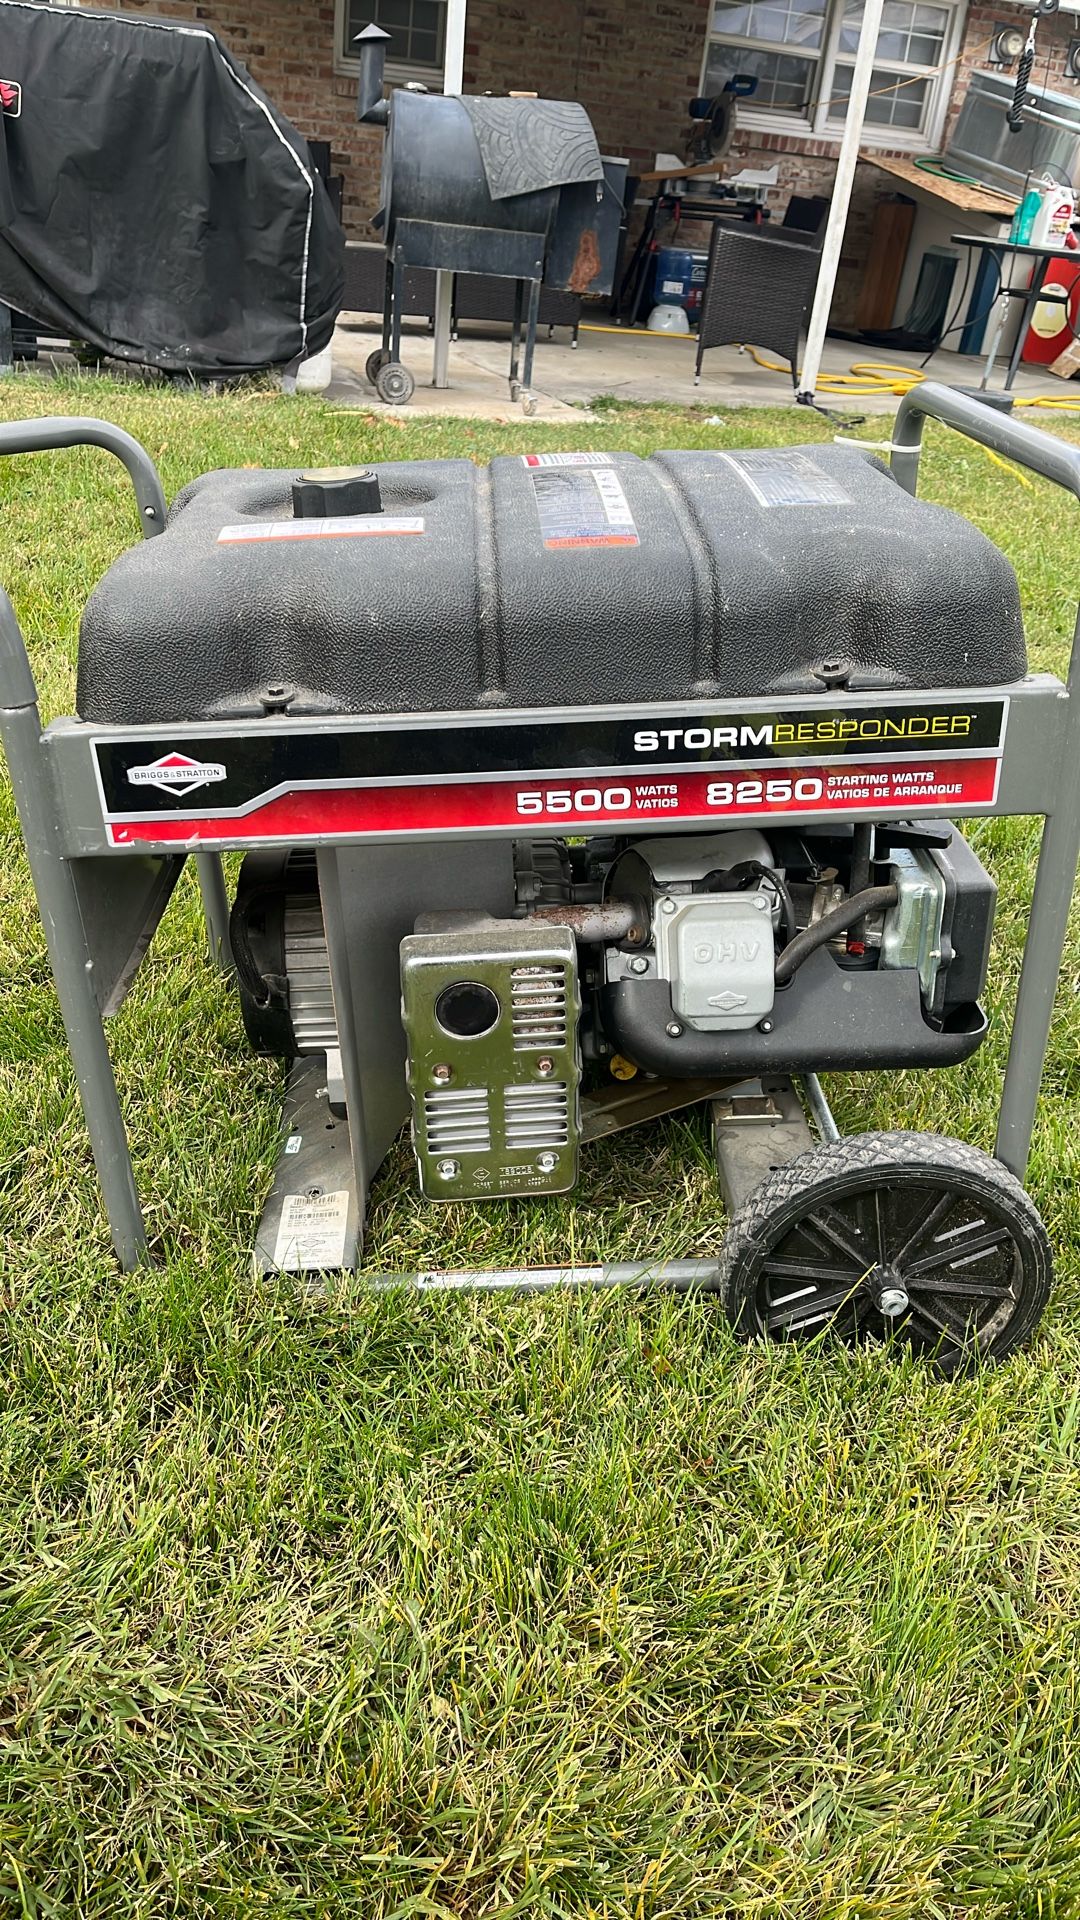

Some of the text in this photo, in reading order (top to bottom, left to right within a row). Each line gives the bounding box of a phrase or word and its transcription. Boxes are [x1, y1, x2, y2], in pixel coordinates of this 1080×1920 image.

[516, 785, 678, 815] 5500 WATTS
[706, 772, 935, 805] 8250 STARTING WATTS
[826, 784, 963, 800] VATIOS DE ARRANQUE
[635, 798, 679, 809] VATIOS
[694, 941, 760, 964] OHV
